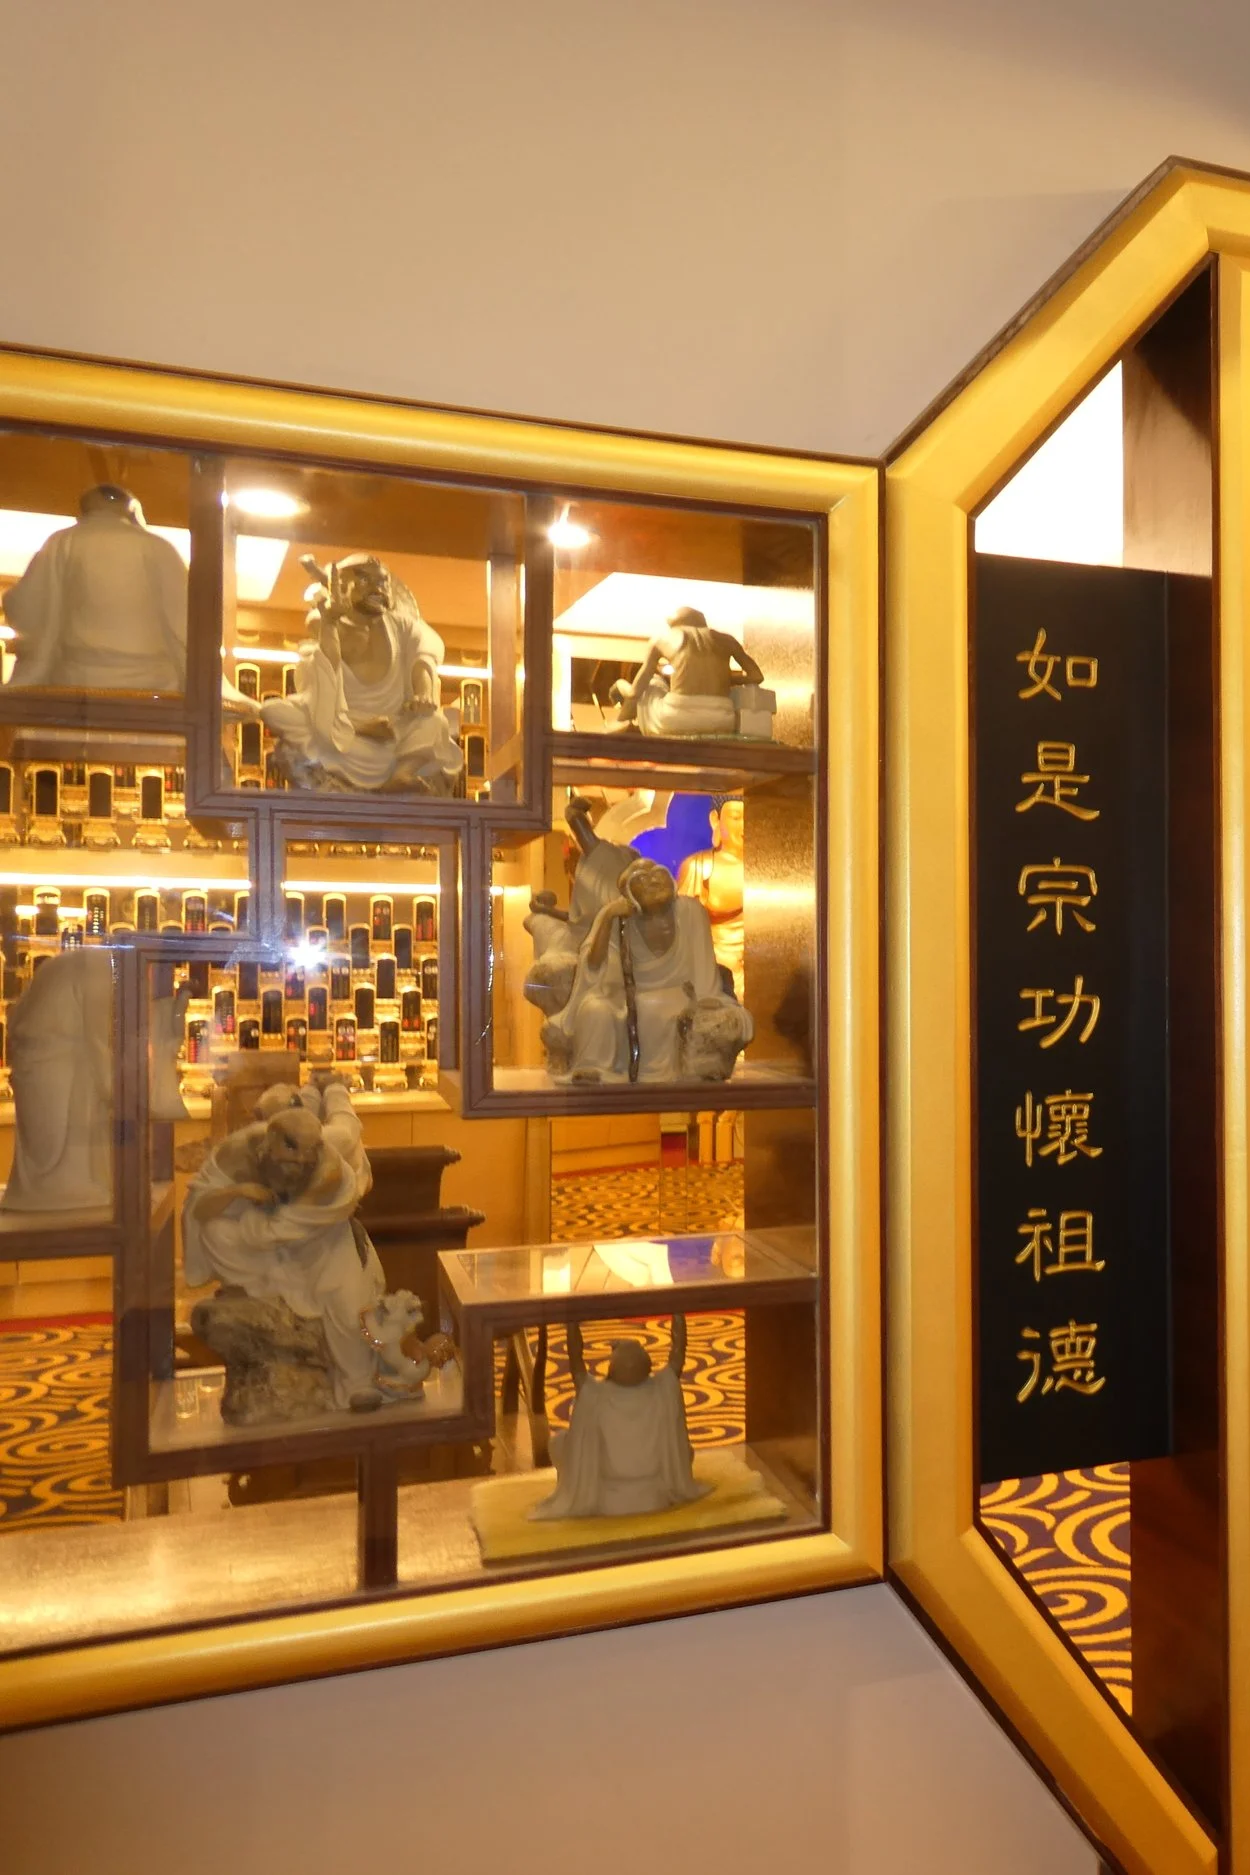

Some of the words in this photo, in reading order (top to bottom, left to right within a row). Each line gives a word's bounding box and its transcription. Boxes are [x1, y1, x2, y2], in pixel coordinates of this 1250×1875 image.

[1016, 626, 1106, 1404] 如是宗功懷祖德
